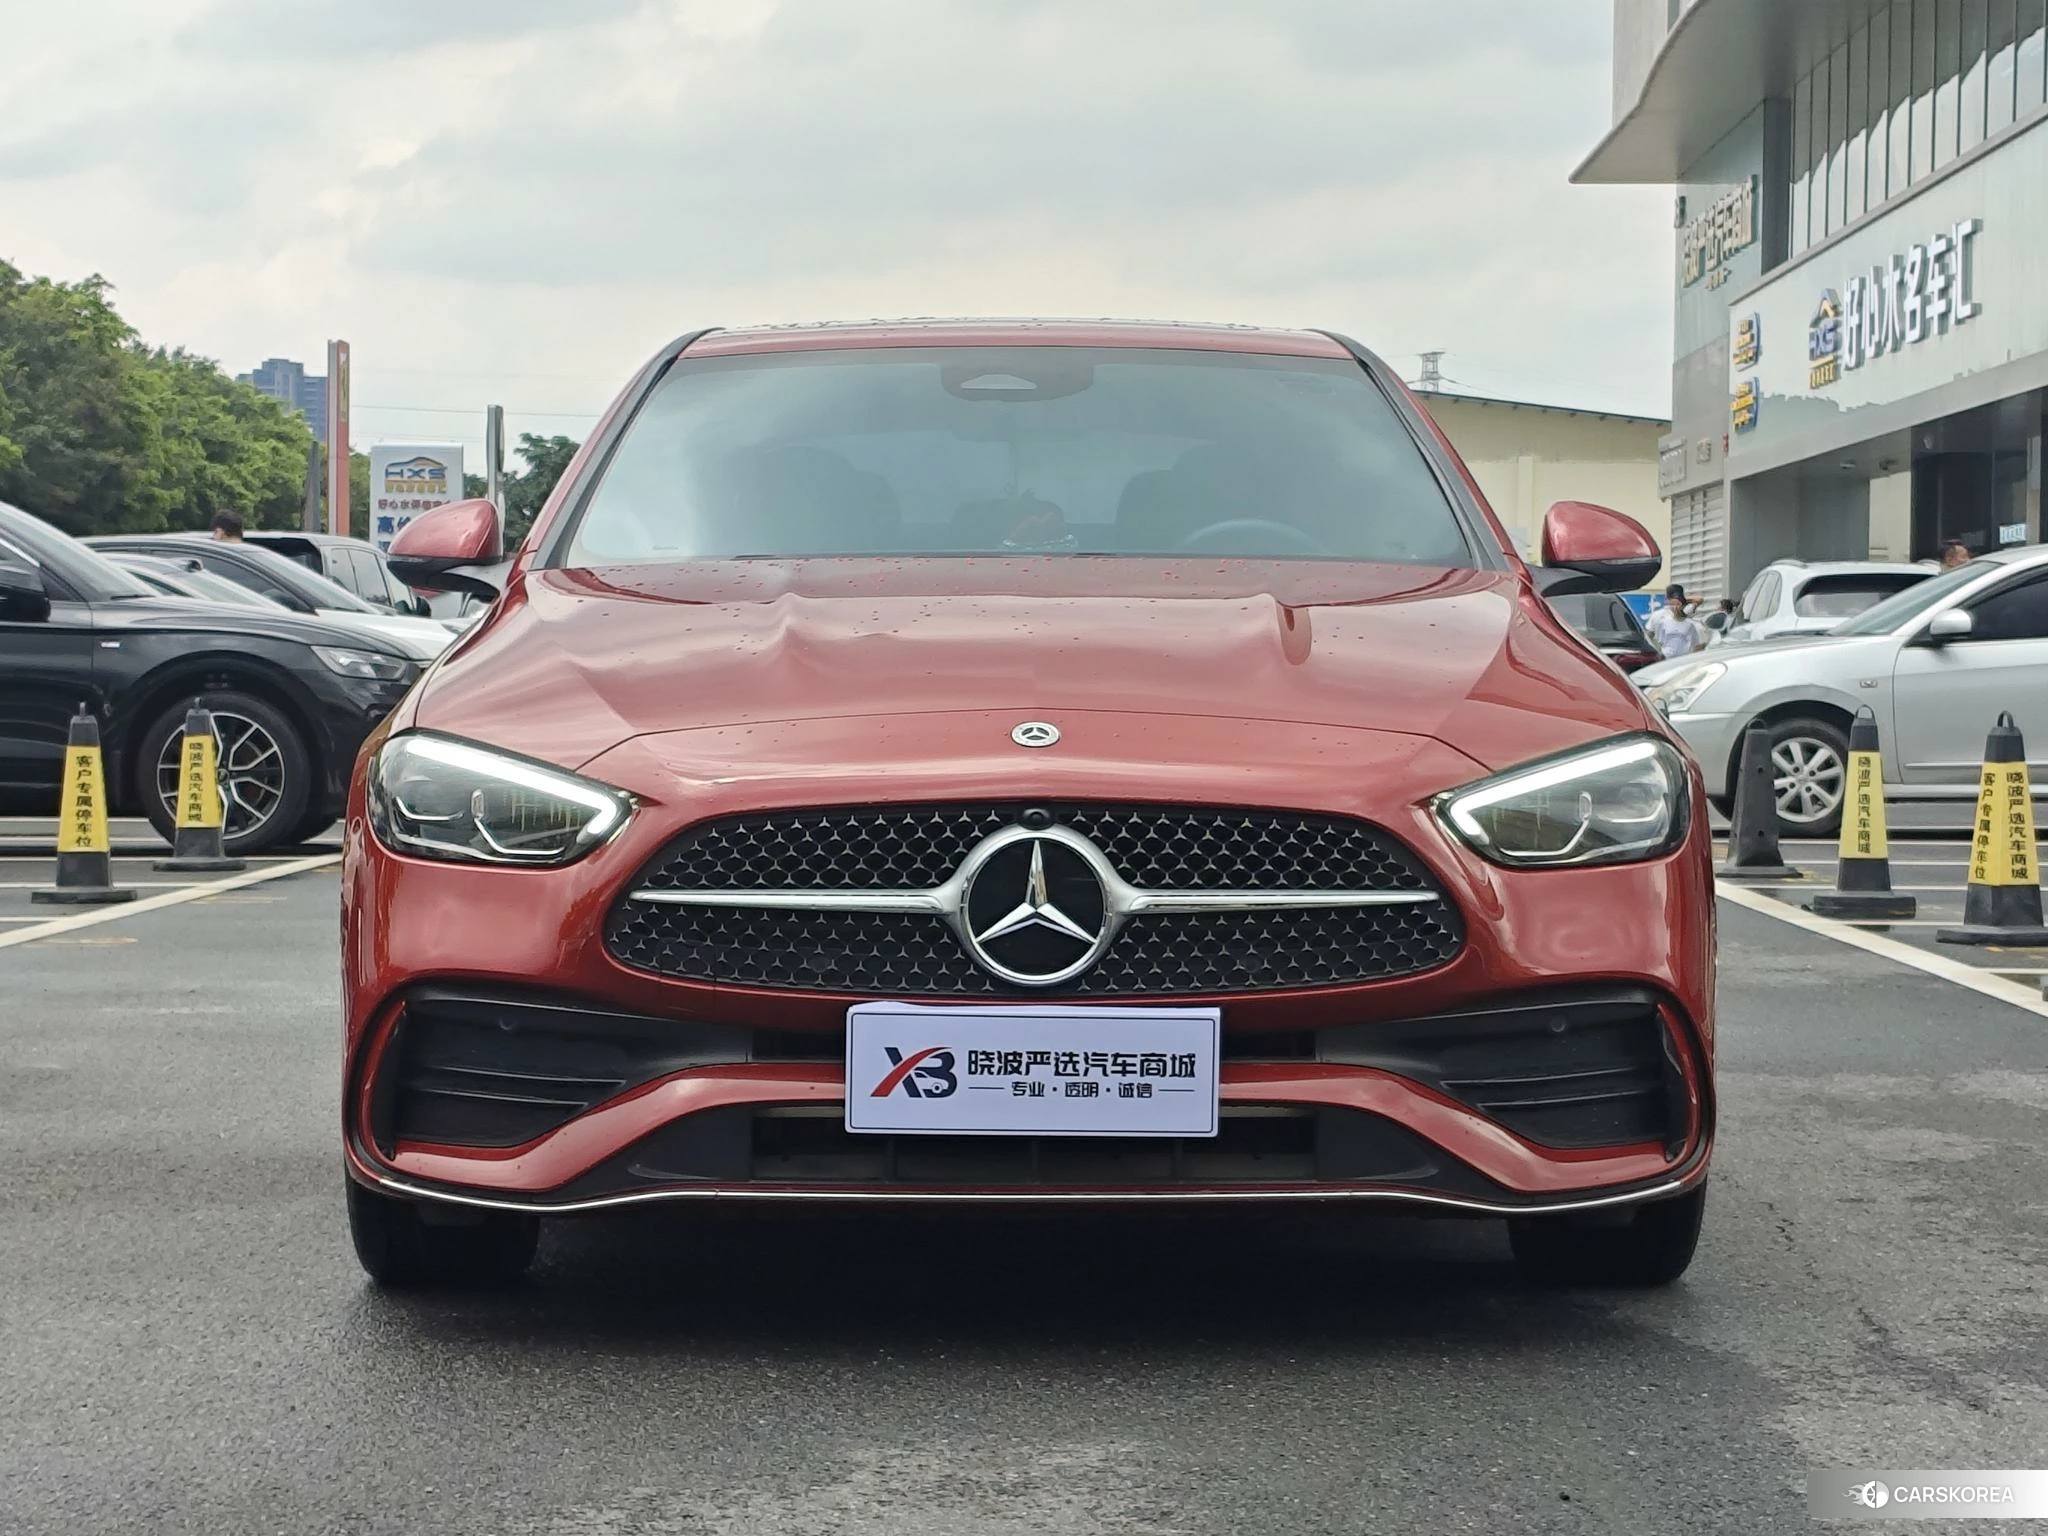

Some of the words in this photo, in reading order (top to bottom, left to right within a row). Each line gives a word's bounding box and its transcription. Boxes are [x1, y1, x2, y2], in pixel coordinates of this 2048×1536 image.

[384, 466, 447, 480] HXS
[75, 755, 93, 848] 客户专属停车位
[1974, 772, 1996, 880] 客户专属停车位
[2006, 771, 2029, 880] 晓波严选汽车商城
[967, 1049, 1197, 1079] 晓波严选汽车商城
